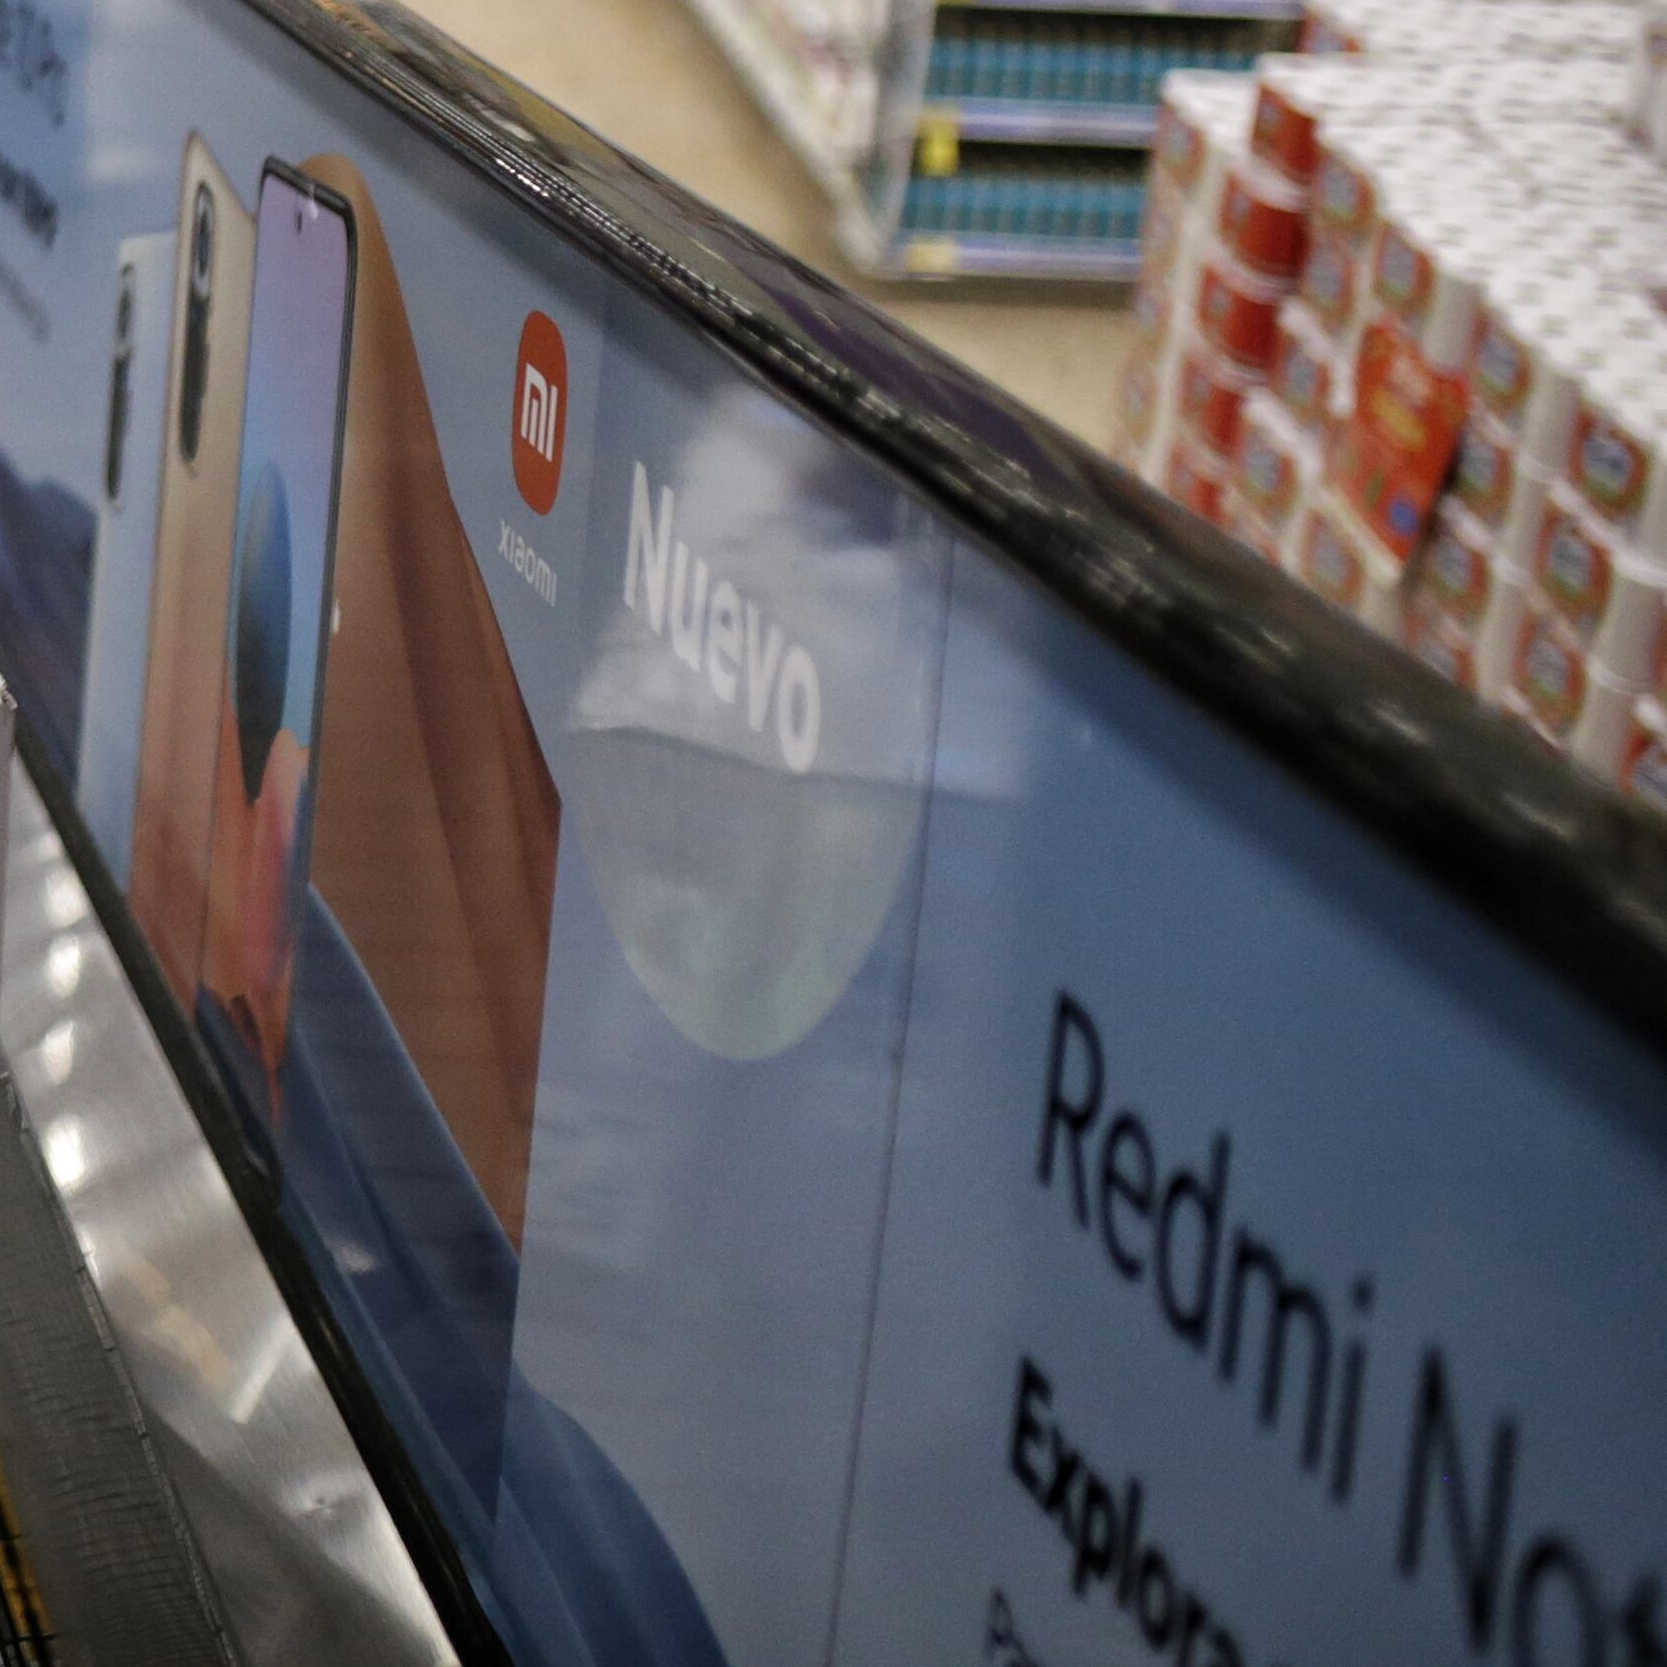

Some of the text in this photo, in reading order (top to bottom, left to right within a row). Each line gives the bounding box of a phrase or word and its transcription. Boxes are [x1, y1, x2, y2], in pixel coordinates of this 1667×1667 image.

[498, 519, 558, 607] xiaomi
[623, 460, 821, 773] Nuevo
[1035, 986, 1374, 1507] Redmi
